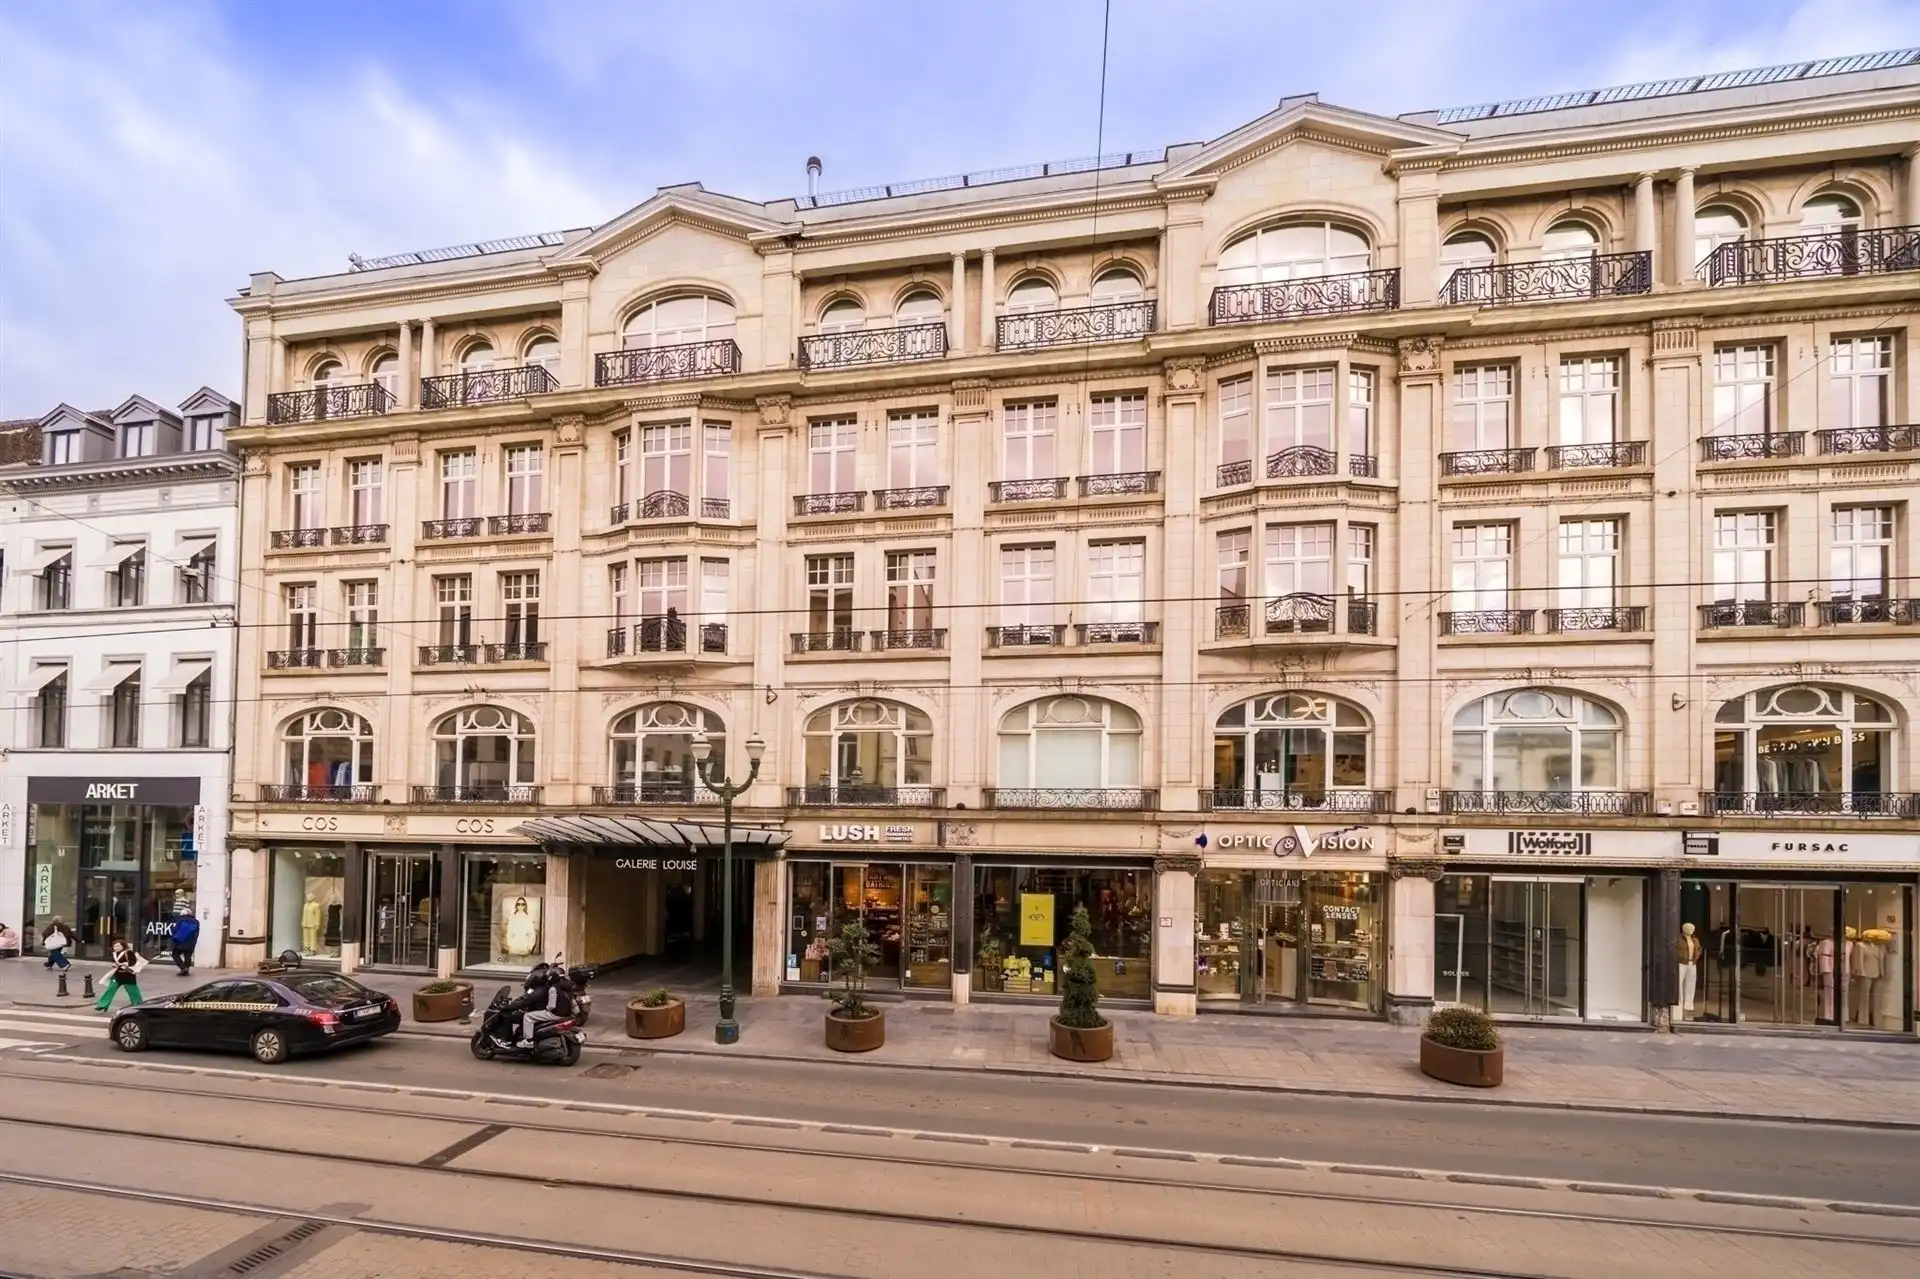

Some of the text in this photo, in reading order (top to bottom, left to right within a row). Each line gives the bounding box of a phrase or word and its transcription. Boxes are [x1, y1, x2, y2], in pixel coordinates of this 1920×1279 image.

[1834, 732, 1866, 744] BSS
[85, 783, 138, 799] ARKET
[2, 803, 10, 844] ARKET
[198, 806, 206, 849] ARKET
[302, 816, 338, 831] COS
[455, 818, 495, 834] COS
[820, 824, 880, 841] LUSH
[1218, 834, 1272, 849] OPTIC
[1294, 825, 1375, 858] VISION
[1521, 836, 1578, 850] Wolford
[1771, 842, 1850, 852] FURSAC
[616, 858, 697, 871] GALERIE LOUISE
[39, 865, 50, 913] ARKET
[1260, 879, 1300, 888] OPTICIANS
[1323, 905, 1360, 913] CONTACT
[1326, 911, 1358, 920] LENSES
[146, 921, 177, 936] ARK
